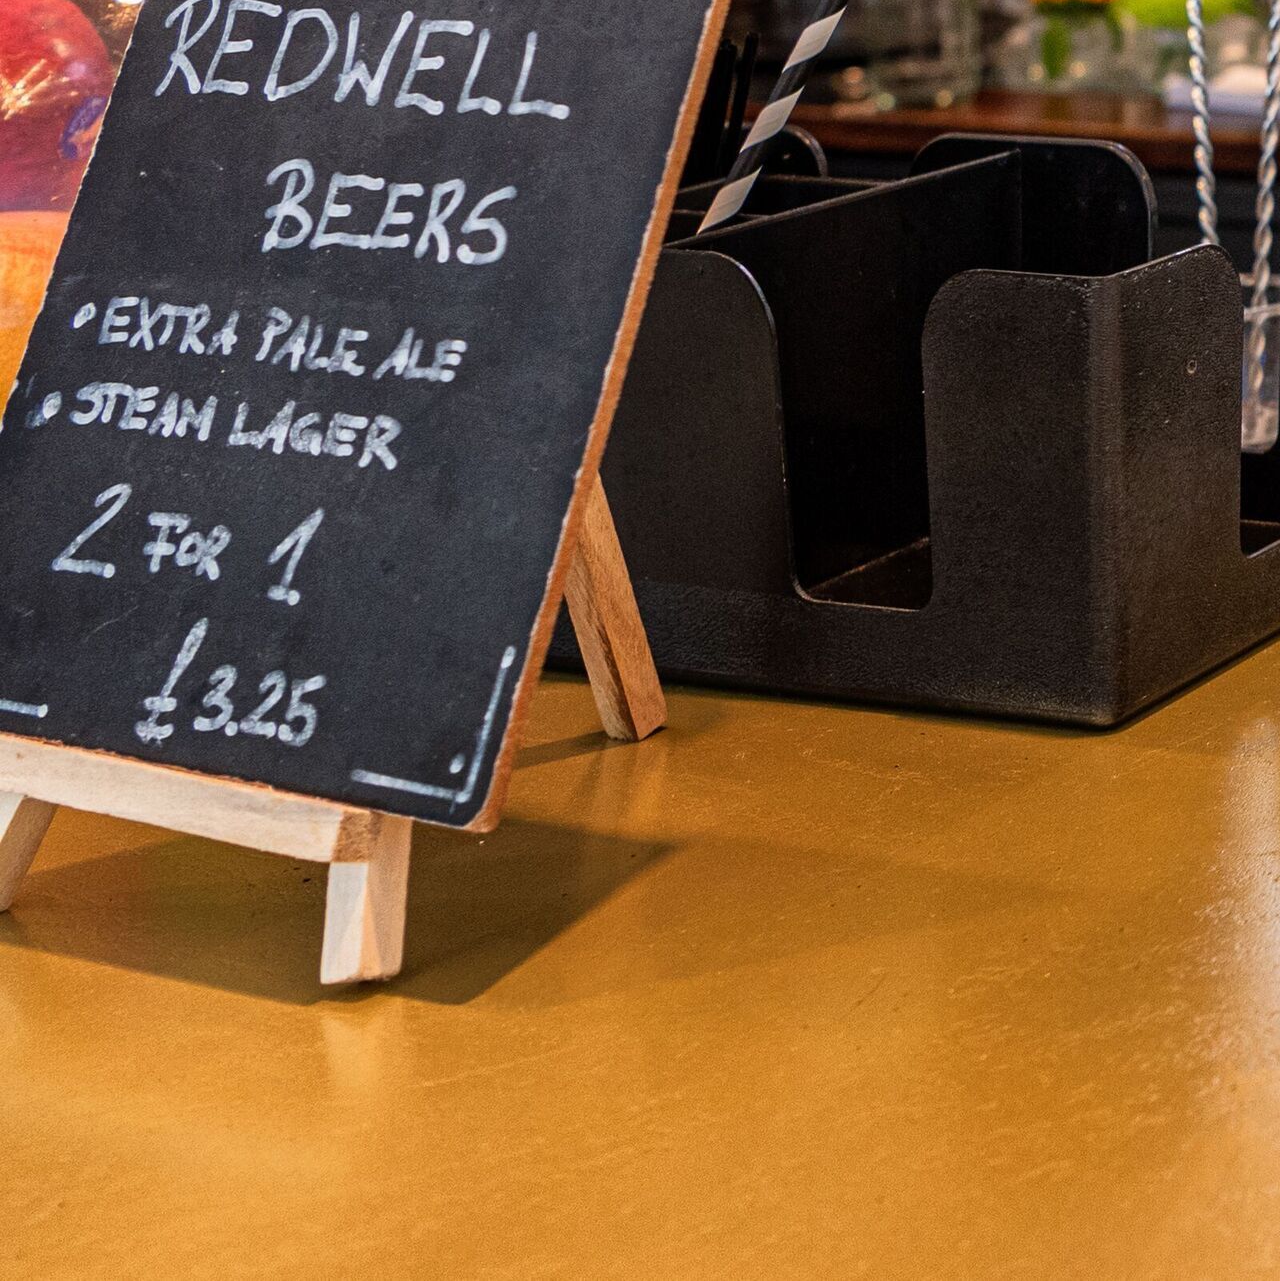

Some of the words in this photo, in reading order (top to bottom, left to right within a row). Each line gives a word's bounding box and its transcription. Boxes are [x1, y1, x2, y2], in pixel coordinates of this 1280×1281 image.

[262, 158, 518, 264] BEERS
[100, 297, 239, 355] EXTRA
[255, 307, 368, 374] PALE
[373, 328, 467, 382] ALE
[70, 382, 217, 441] STEAM
[227, 400, 401, 470] LAGER
[52, 483, 132, 578] 2
[144, 512, 231, 580] FOR
[267, 508, 324, 605] 1
[136, 619, 327, 745] £3.25
